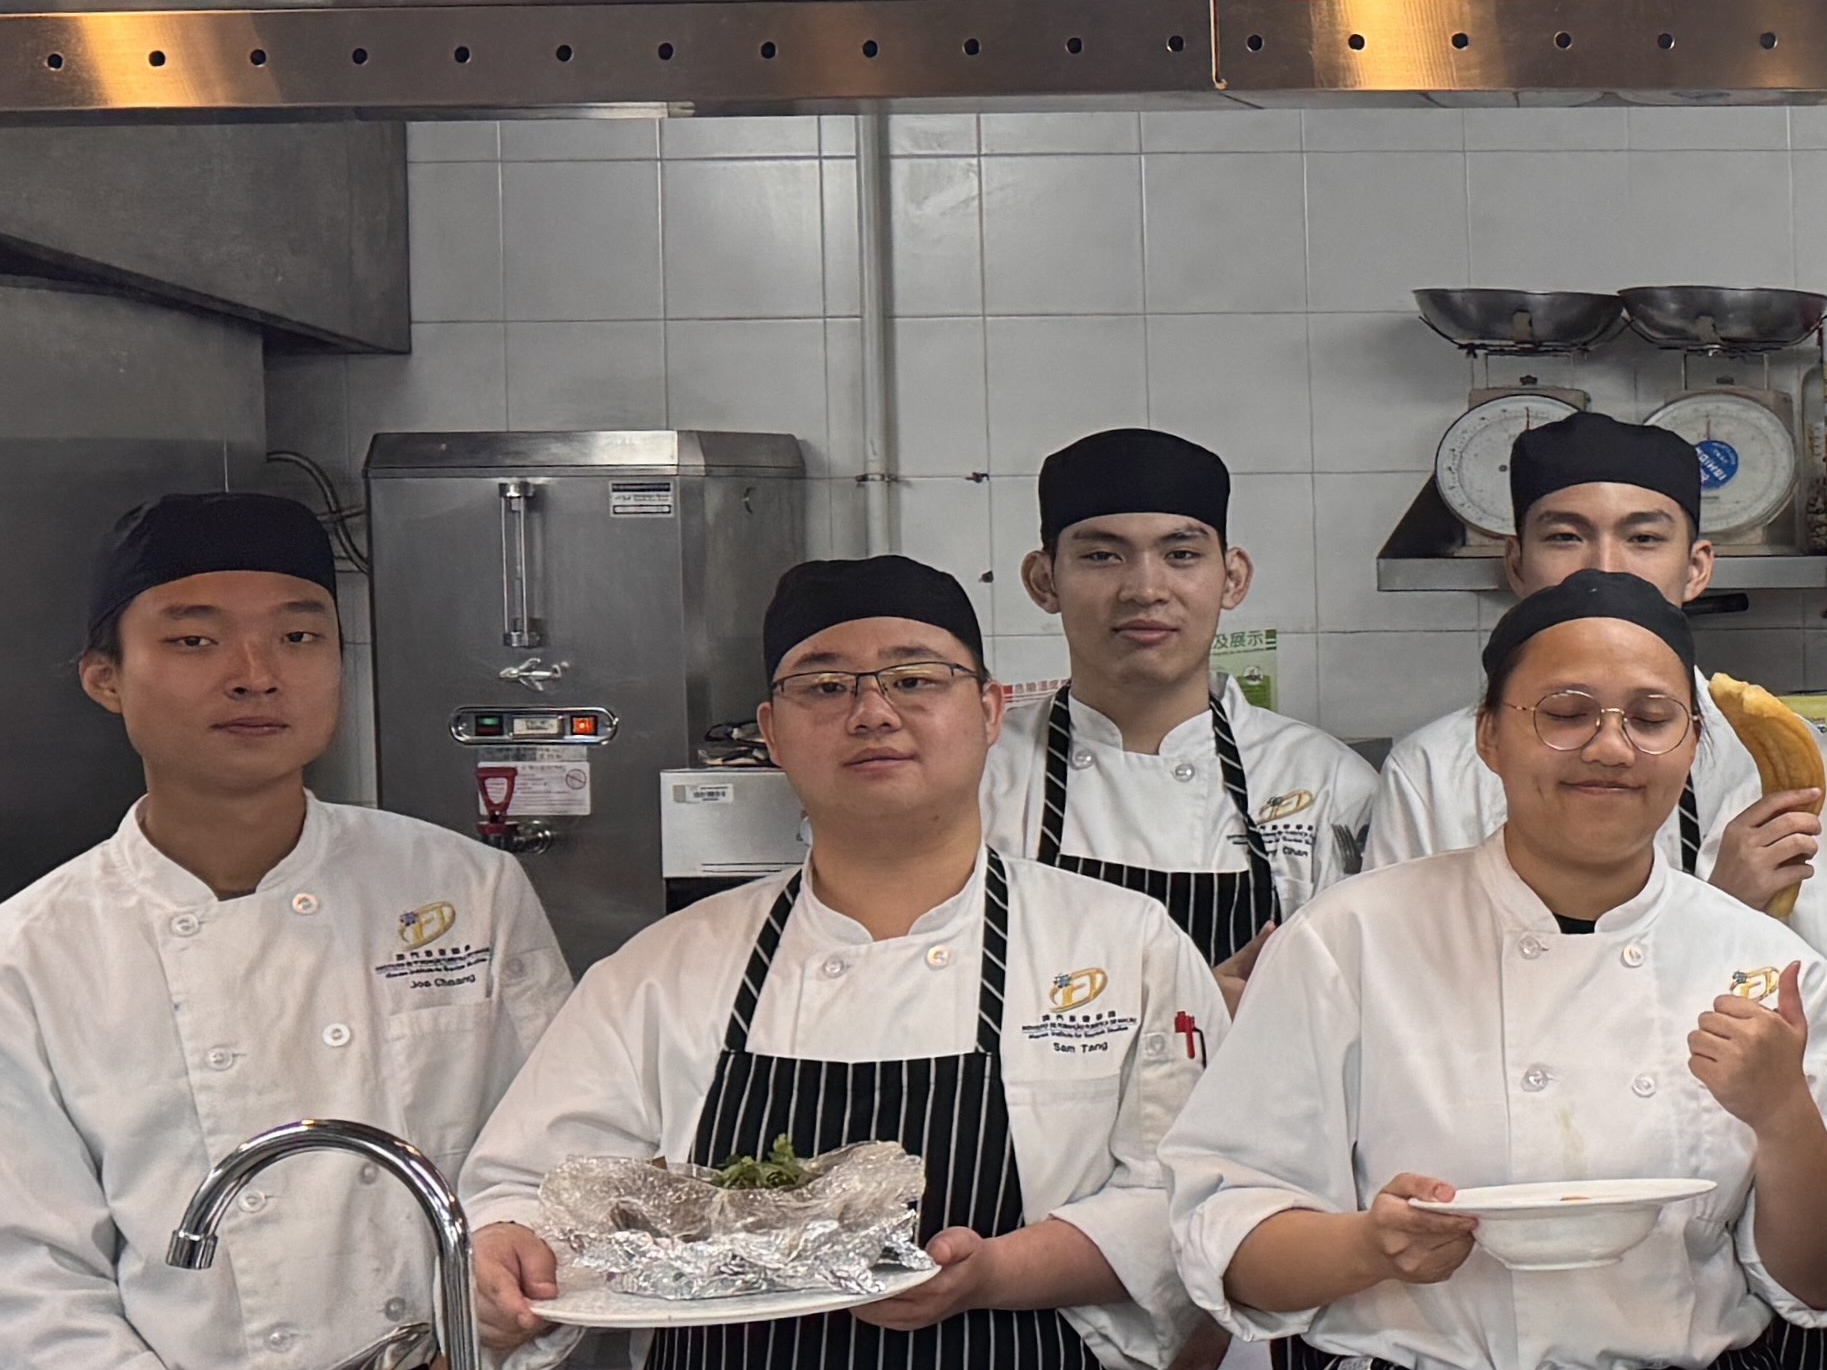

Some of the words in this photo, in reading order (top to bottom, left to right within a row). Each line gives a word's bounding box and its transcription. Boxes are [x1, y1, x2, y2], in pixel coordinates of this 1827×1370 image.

[1214, 630, 1263, 650] 及展示
[1053, 1042, 1076, 1054] Sam
[1081, 1041, 1109, 1053] Tang
